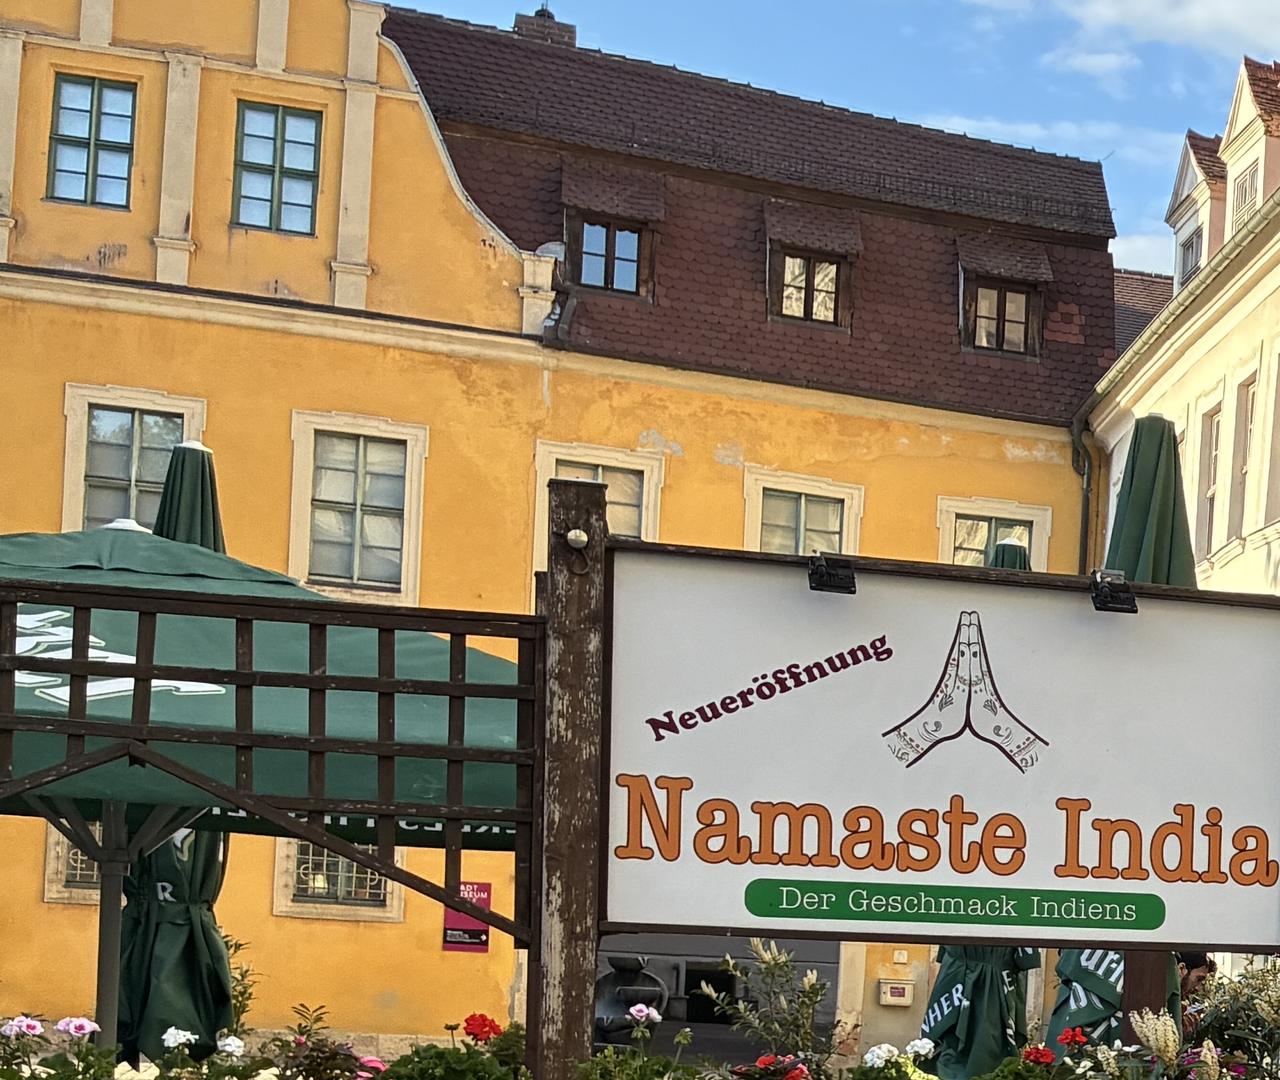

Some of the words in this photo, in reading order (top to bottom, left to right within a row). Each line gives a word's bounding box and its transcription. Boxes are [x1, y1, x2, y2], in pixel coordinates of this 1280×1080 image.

[644, 634, 895, 743] Neueröffnung
[615, 773, 1028, 877] Namaste
[1054, 797, 1279, 887] India
[779, 886, 836, 912] Der
[848, 889, 1018, 919] Geschmack
[1030, 893, 1136, 921] Indiens
